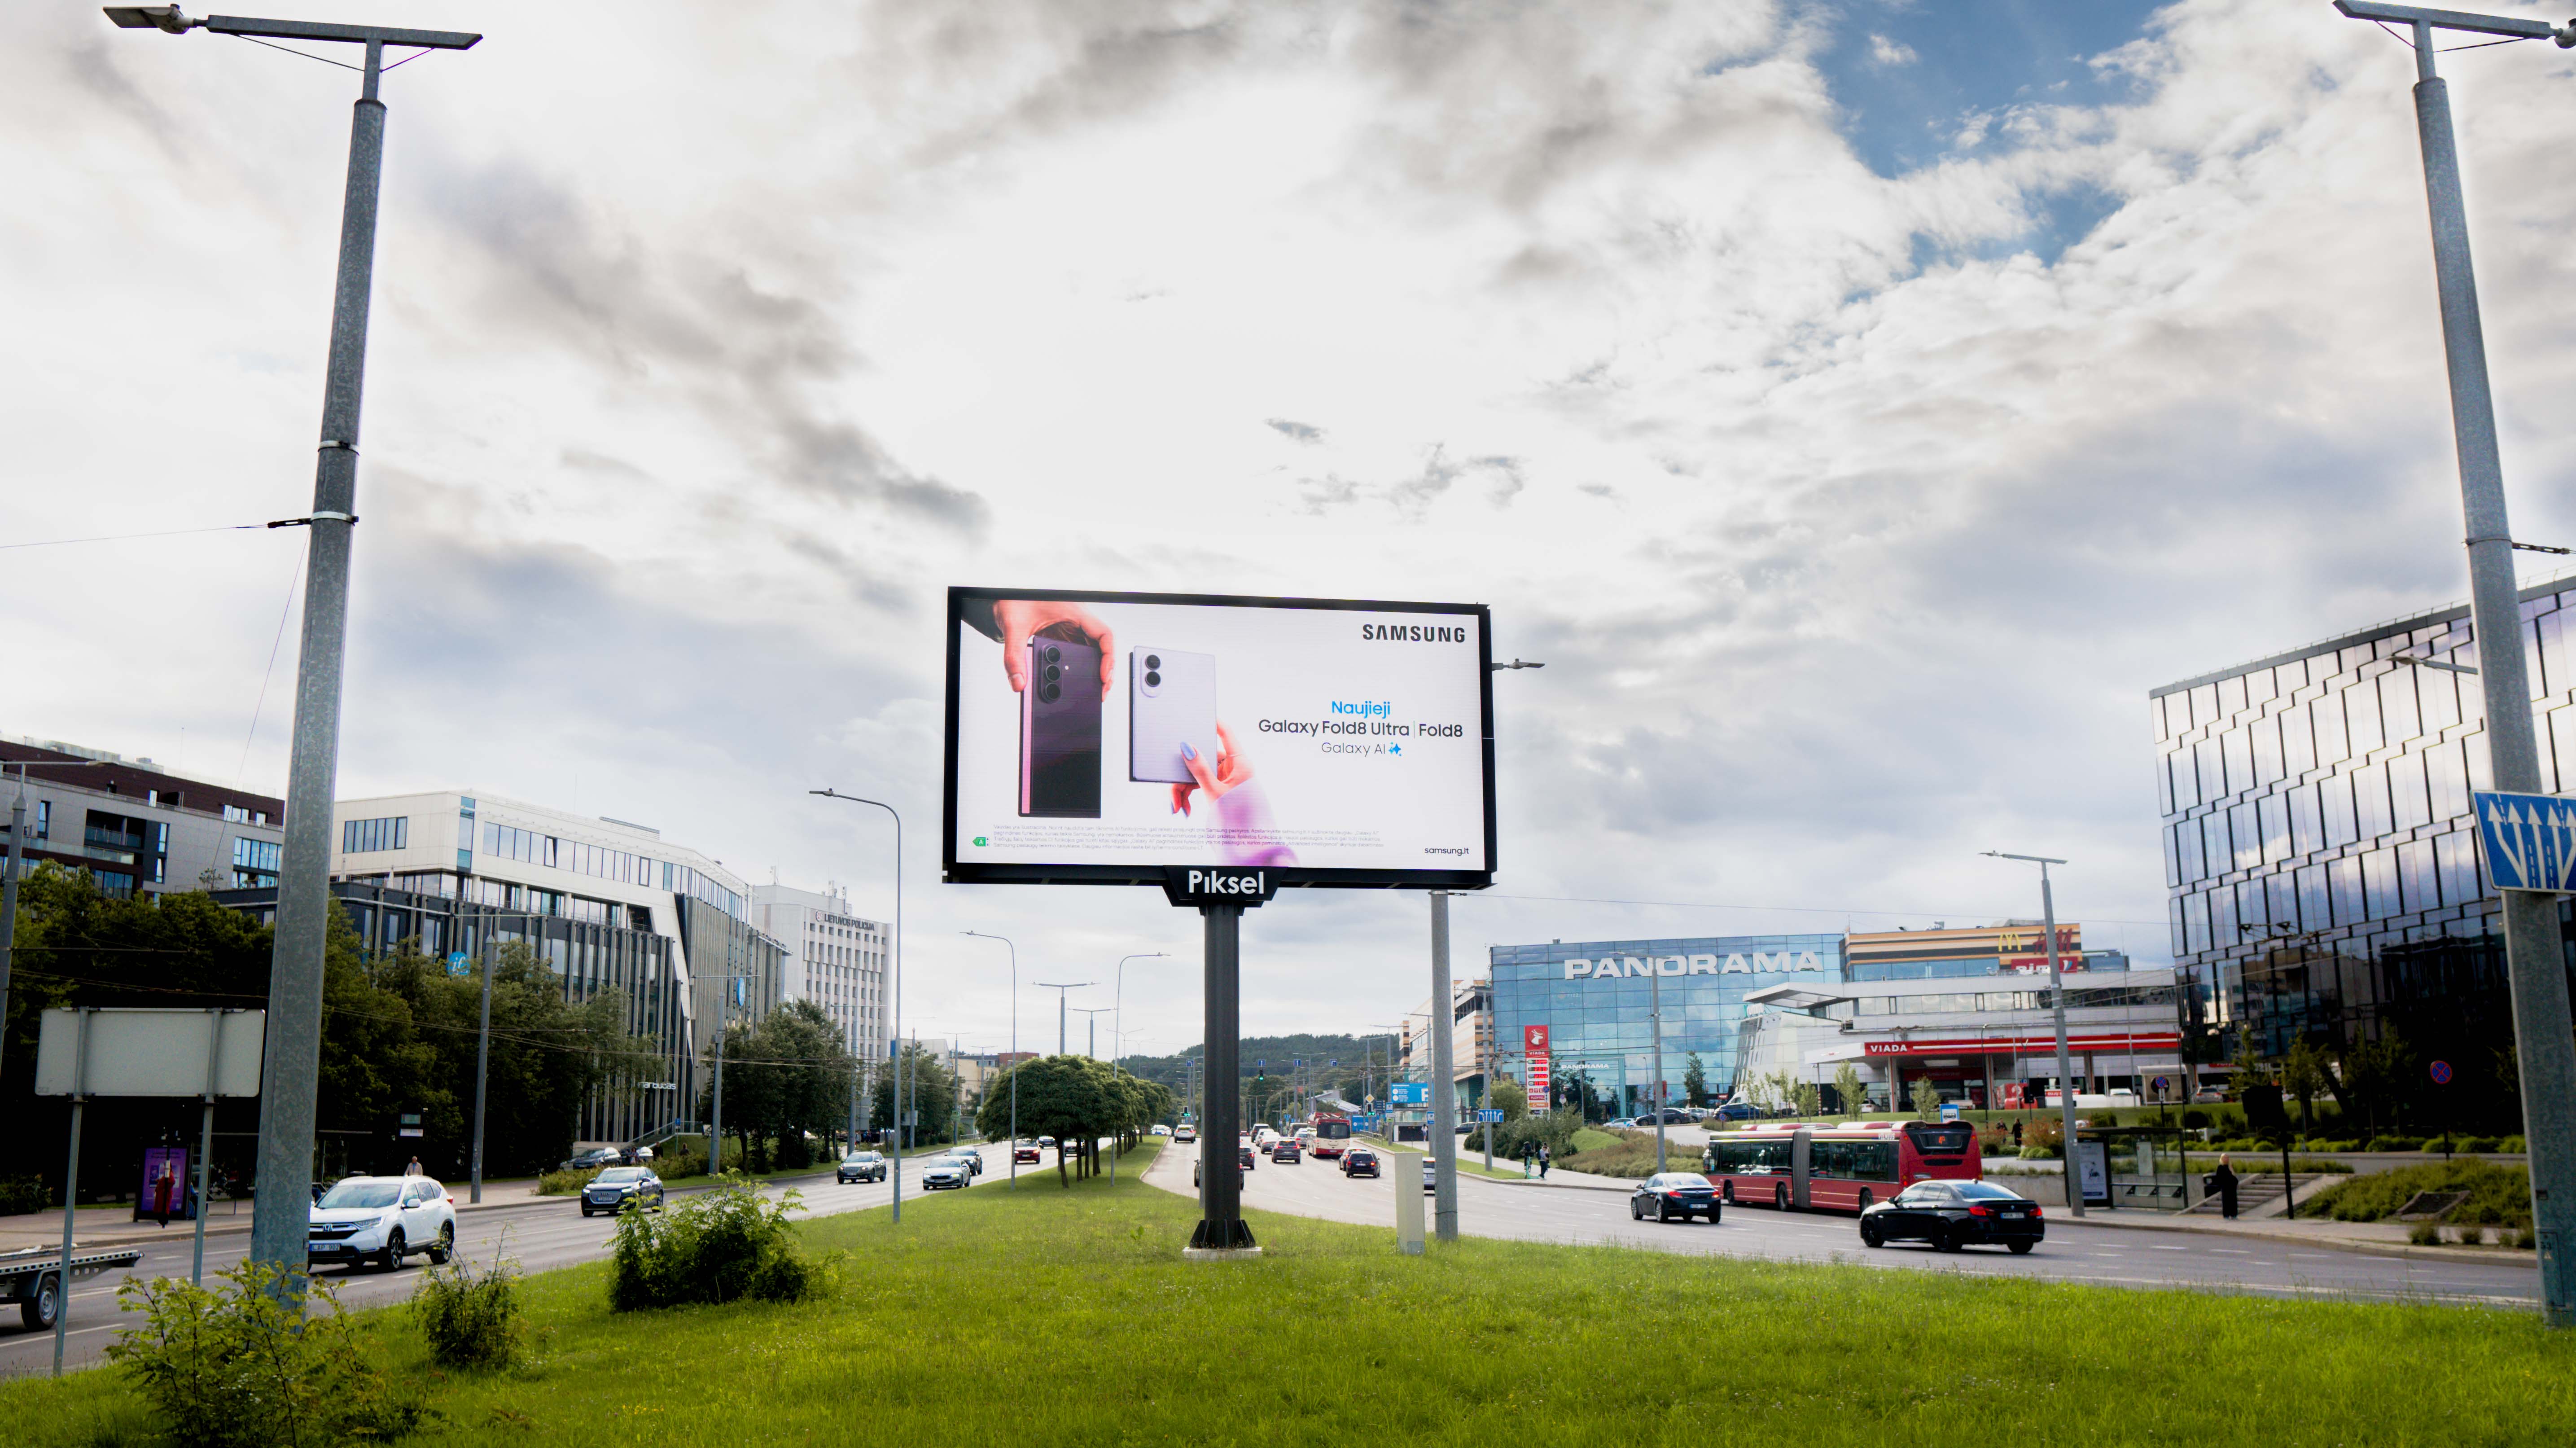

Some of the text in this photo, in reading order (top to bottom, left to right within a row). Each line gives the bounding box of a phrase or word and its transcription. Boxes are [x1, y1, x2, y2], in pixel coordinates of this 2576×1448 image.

[1362, 624, 1465, 643] SAMSUNG
[1332, 701, 1391, 719] Naujieji
[1258, 719, 1463, 737] Galaxy Fold8 Ultra Fold8
[1321, 742, 1385, 757] Galaxy AI
[1425, 847, 1469, 856] samsung.lt
[1189, 871, 1264, 894] Piksel
[824, 913, 875, 931] LIETUVOS POLICIJA
[1564, 951, 1824, 980] PANORAMA
[1870, 1044, 1907, 1053] VIADA
